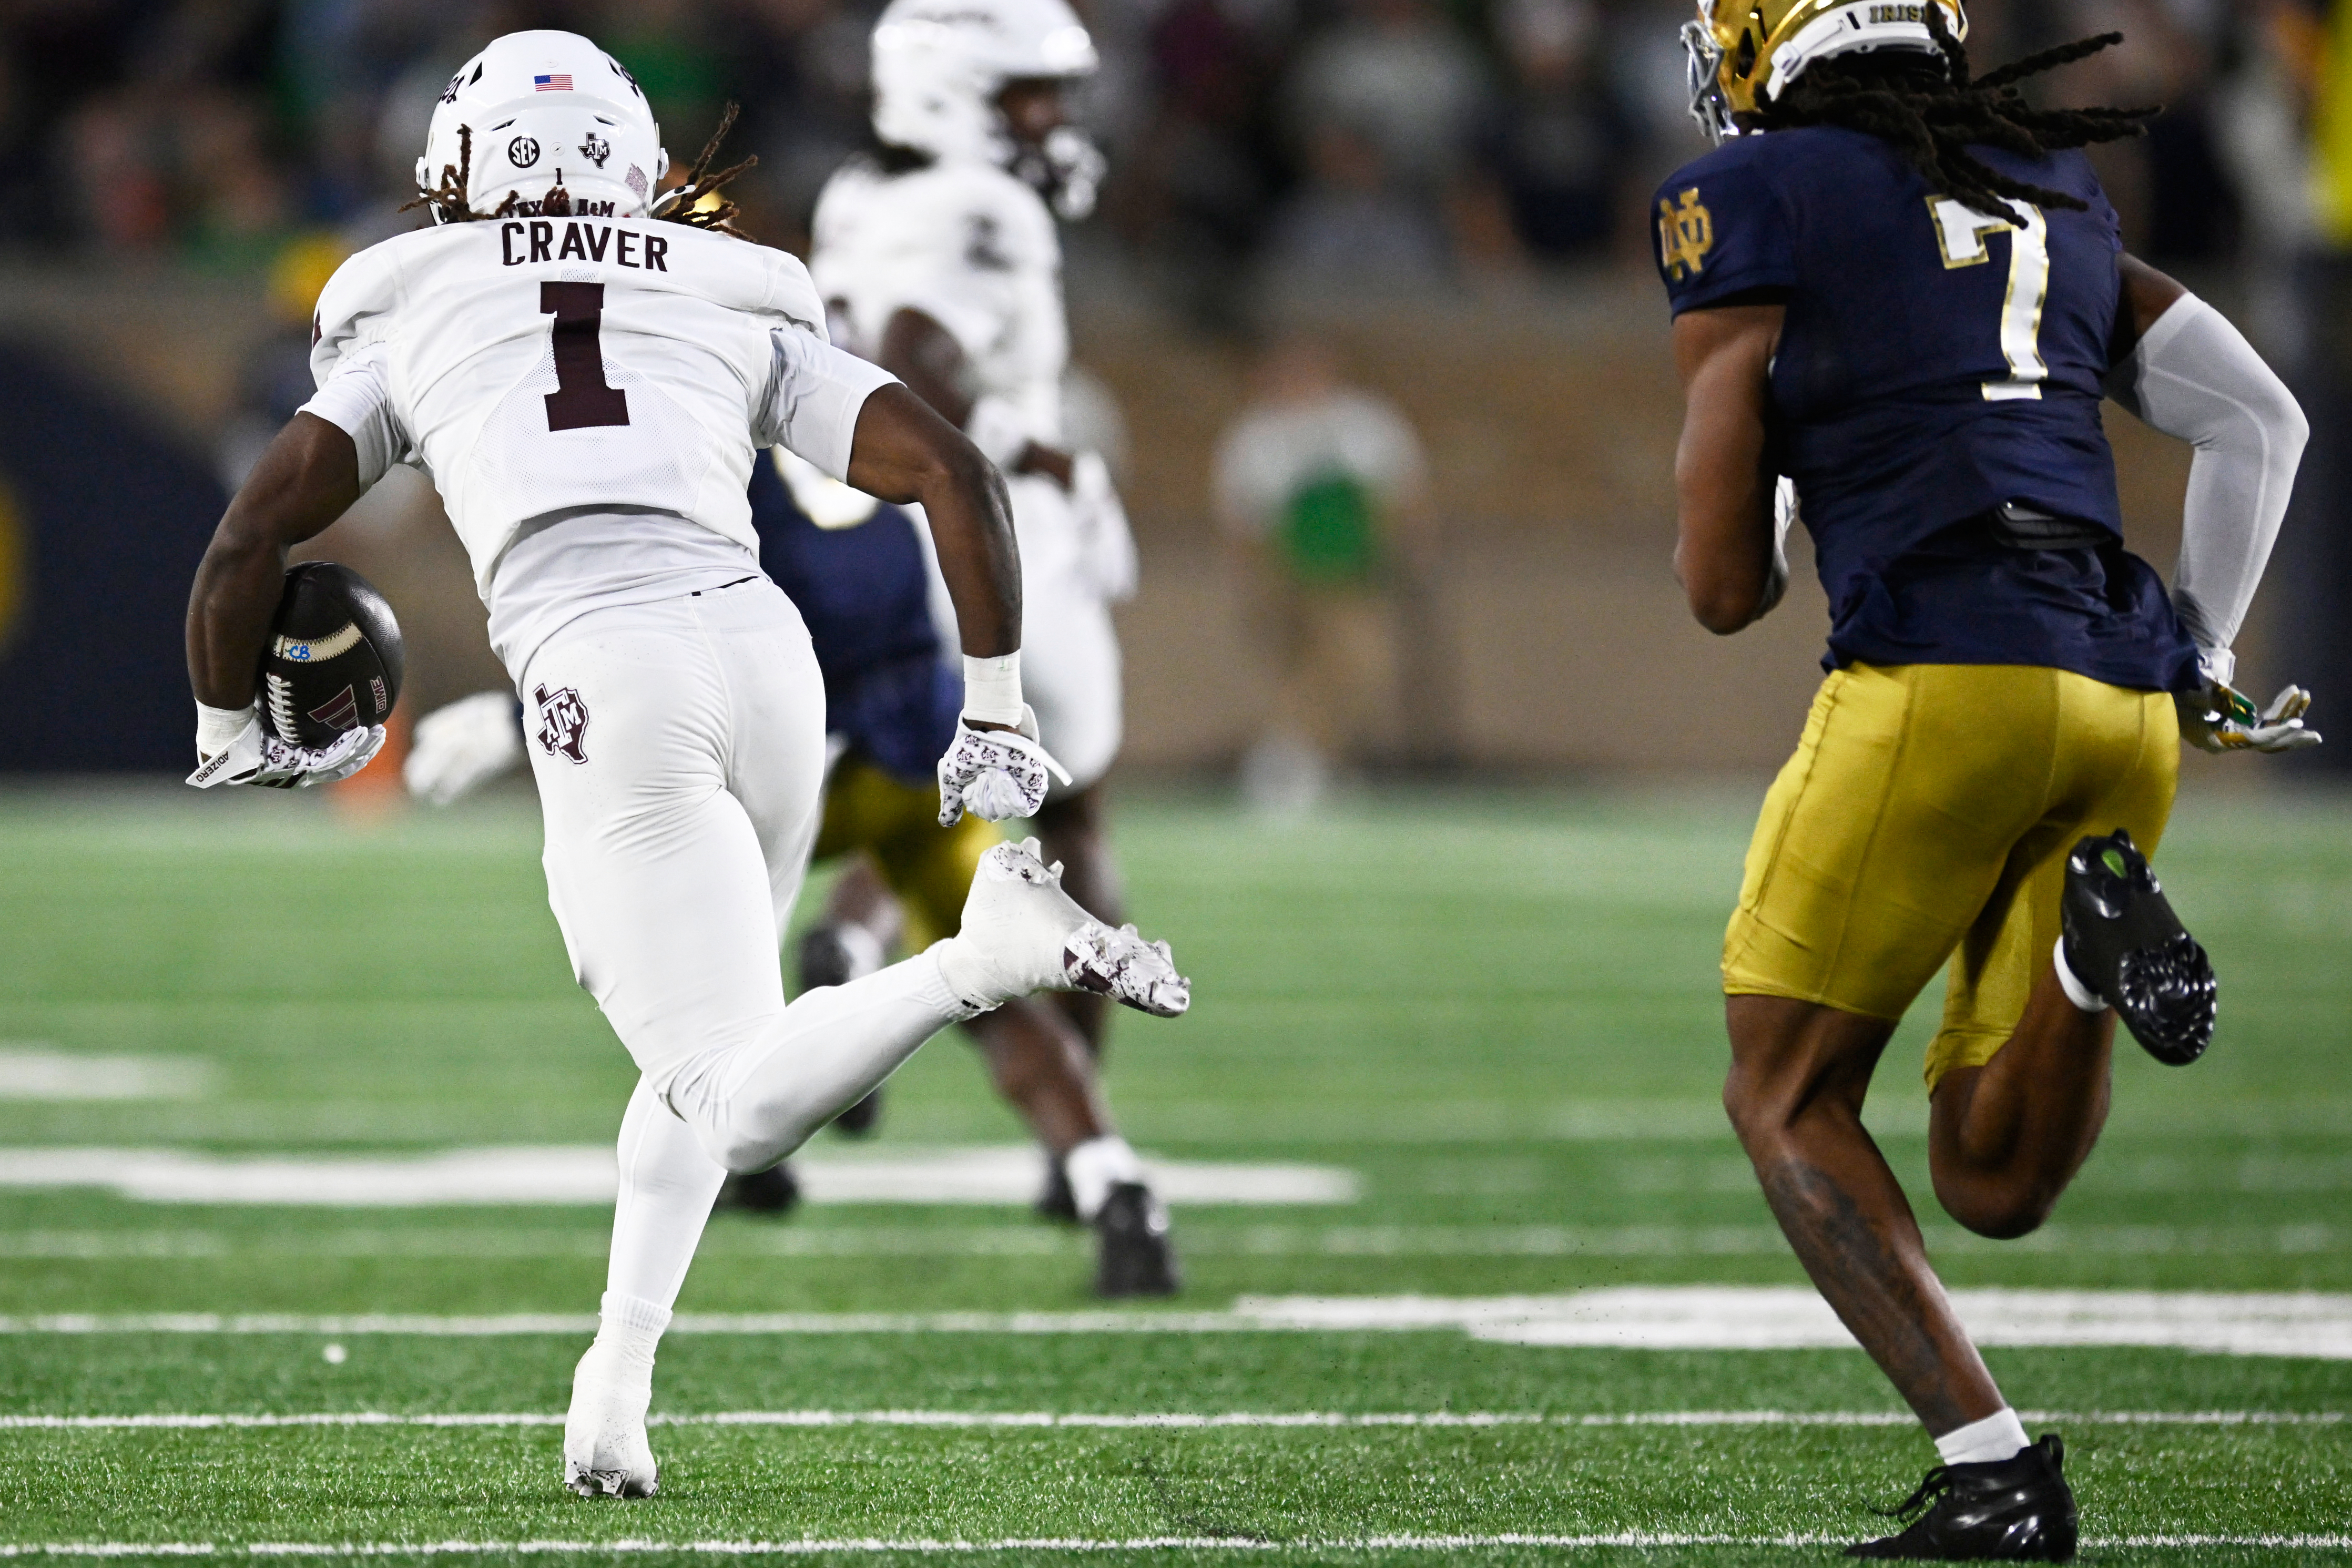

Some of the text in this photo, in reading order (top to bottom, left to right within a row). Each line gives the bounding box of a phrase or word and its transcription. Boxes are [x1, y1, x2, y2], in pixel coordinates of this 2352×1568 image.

[1869, 4, 1928, 24] IRIS
[511, 138, 536, 165] SEC
[555, 167, 563, 185] 1
[501, 221, 668, 272] CRAVER
[1925, 189, 2050, 401] 7
[540, 281, 630, 432] 1
[369, 675, 387, 714] DIME
[196, 750, 229, 782] ADIZERO
